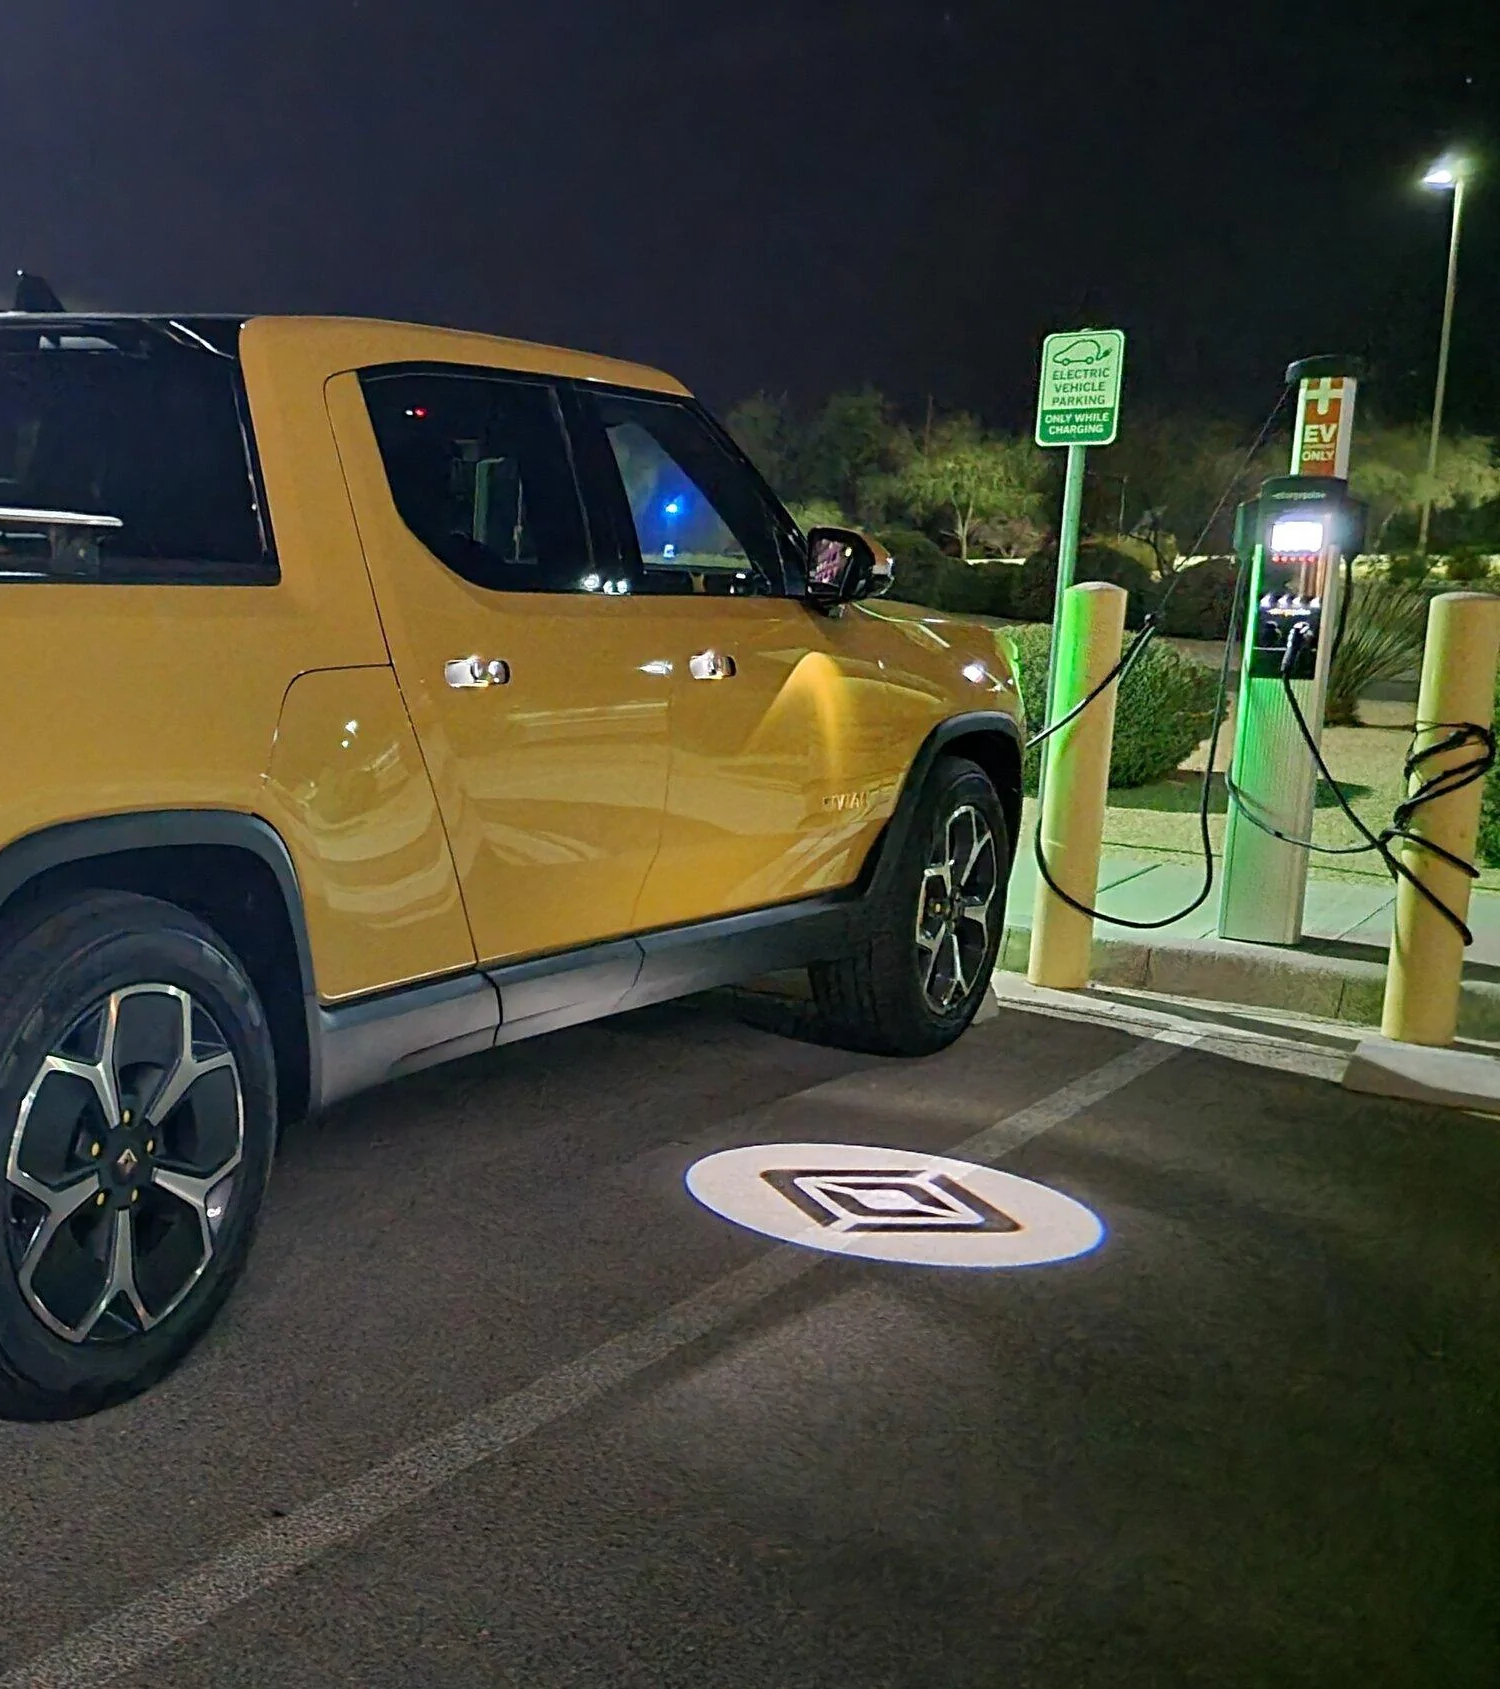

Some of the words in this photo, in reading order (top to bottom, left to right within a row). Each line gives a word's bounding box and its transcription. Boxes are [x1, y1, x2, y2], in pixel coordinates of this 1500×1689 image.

[1052, 368, 1110, 380] ELECTRIC
[1054, 381, 1106, 394] VEHICLE
[1051, 394, 1106, 406] PARKING
[1044, 413, 1073, 424] ONLY
[1074, 412, 1110, 423] WHILE
[1049, 424, 1104, 435] CHARGING
[1303, 423, 1338, 443] EV
[1301, 450, 1335, 462] ONLY
